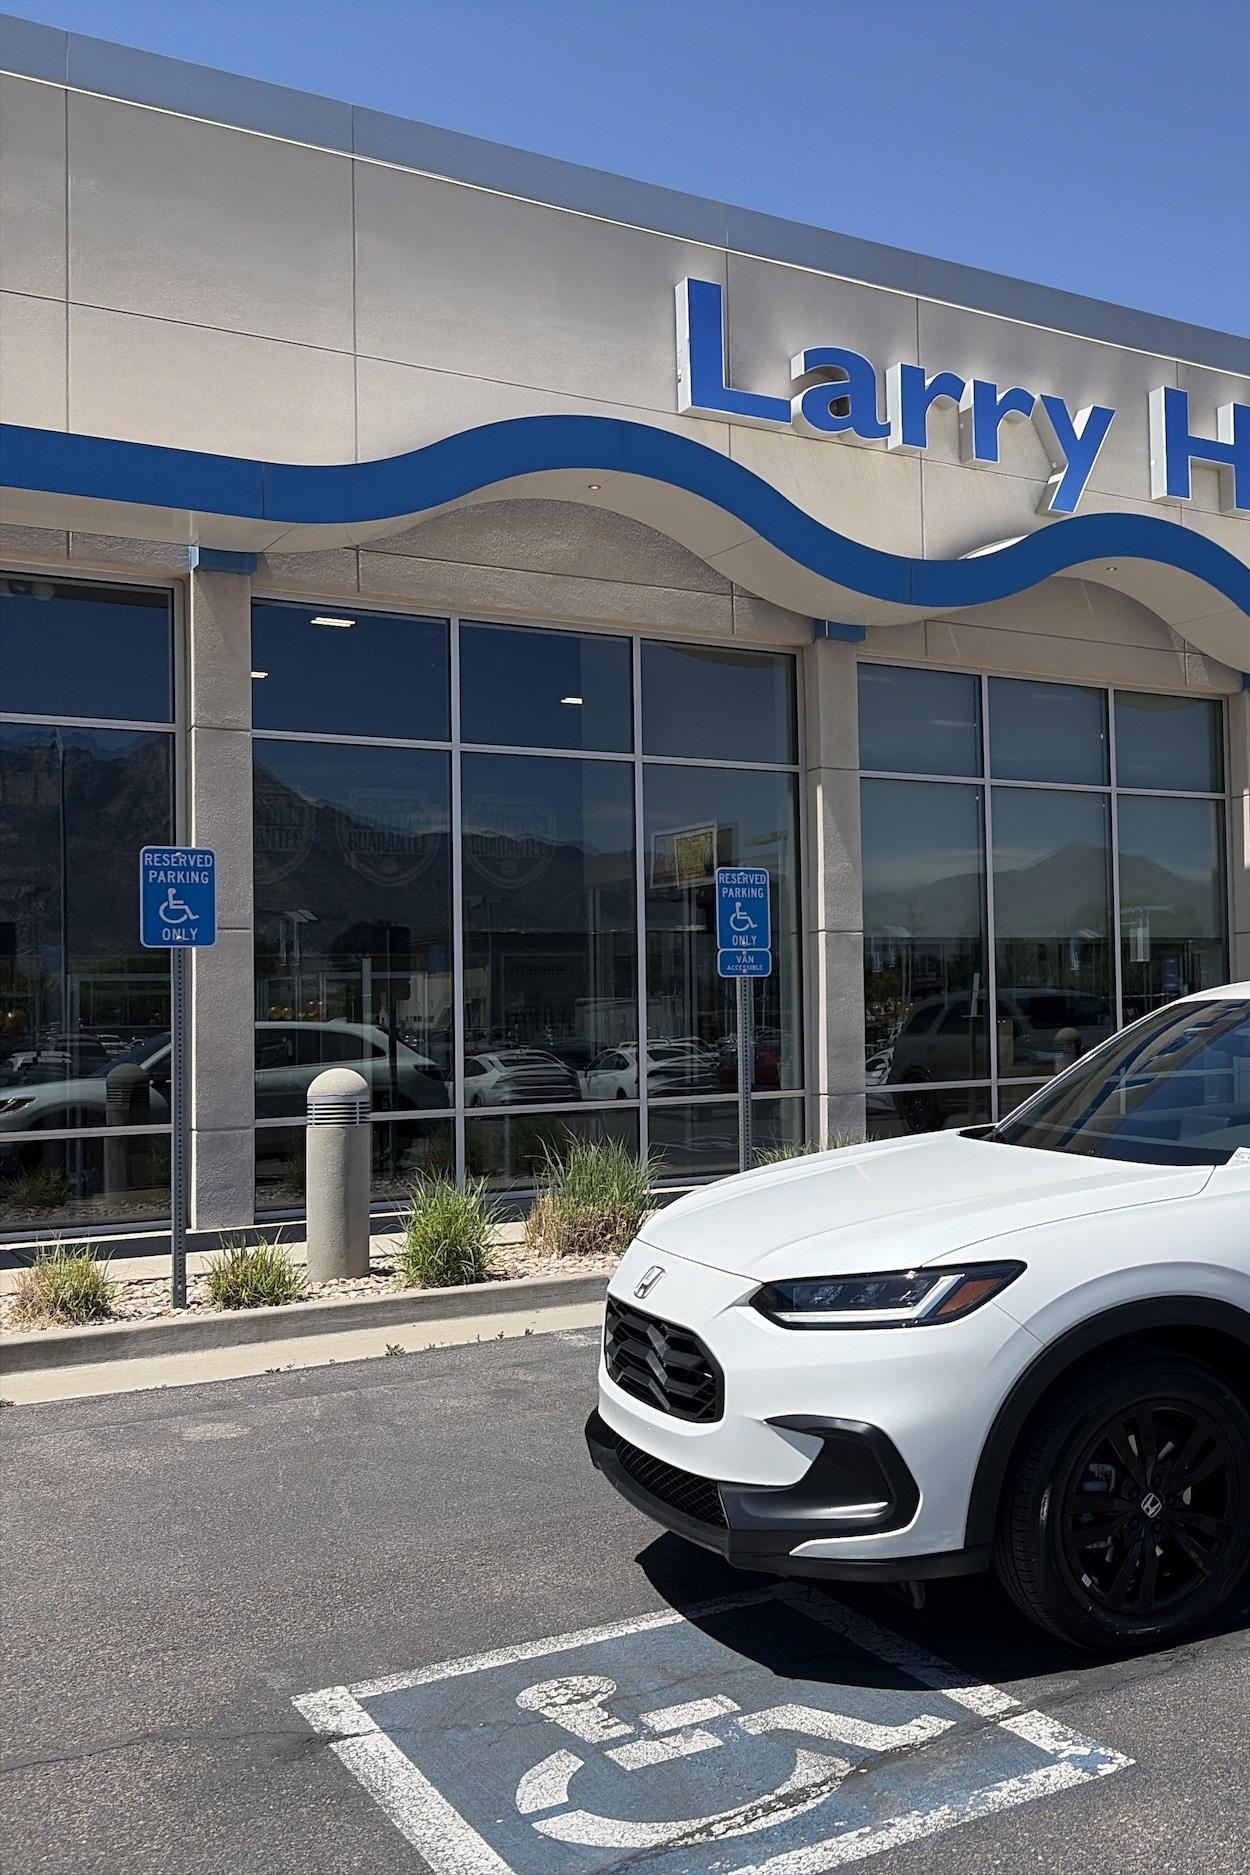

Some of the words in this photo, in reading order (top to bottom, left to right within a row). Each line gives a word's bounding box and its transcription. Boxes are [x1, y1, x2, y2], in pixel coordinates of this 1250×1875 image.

[677, 277, 1116, 515] Larry
[144, 853, 213, 867] RESERVED
[149, 870, 209, 884] PARKING
[719, 873, 766, 884] RESERVED
[721, 887, 764, 898] PARKING
[162, 928, 198, 941] ONLY
[732, 935, 757, 946] ONLY
[736, 955, 754, 963] VAN
